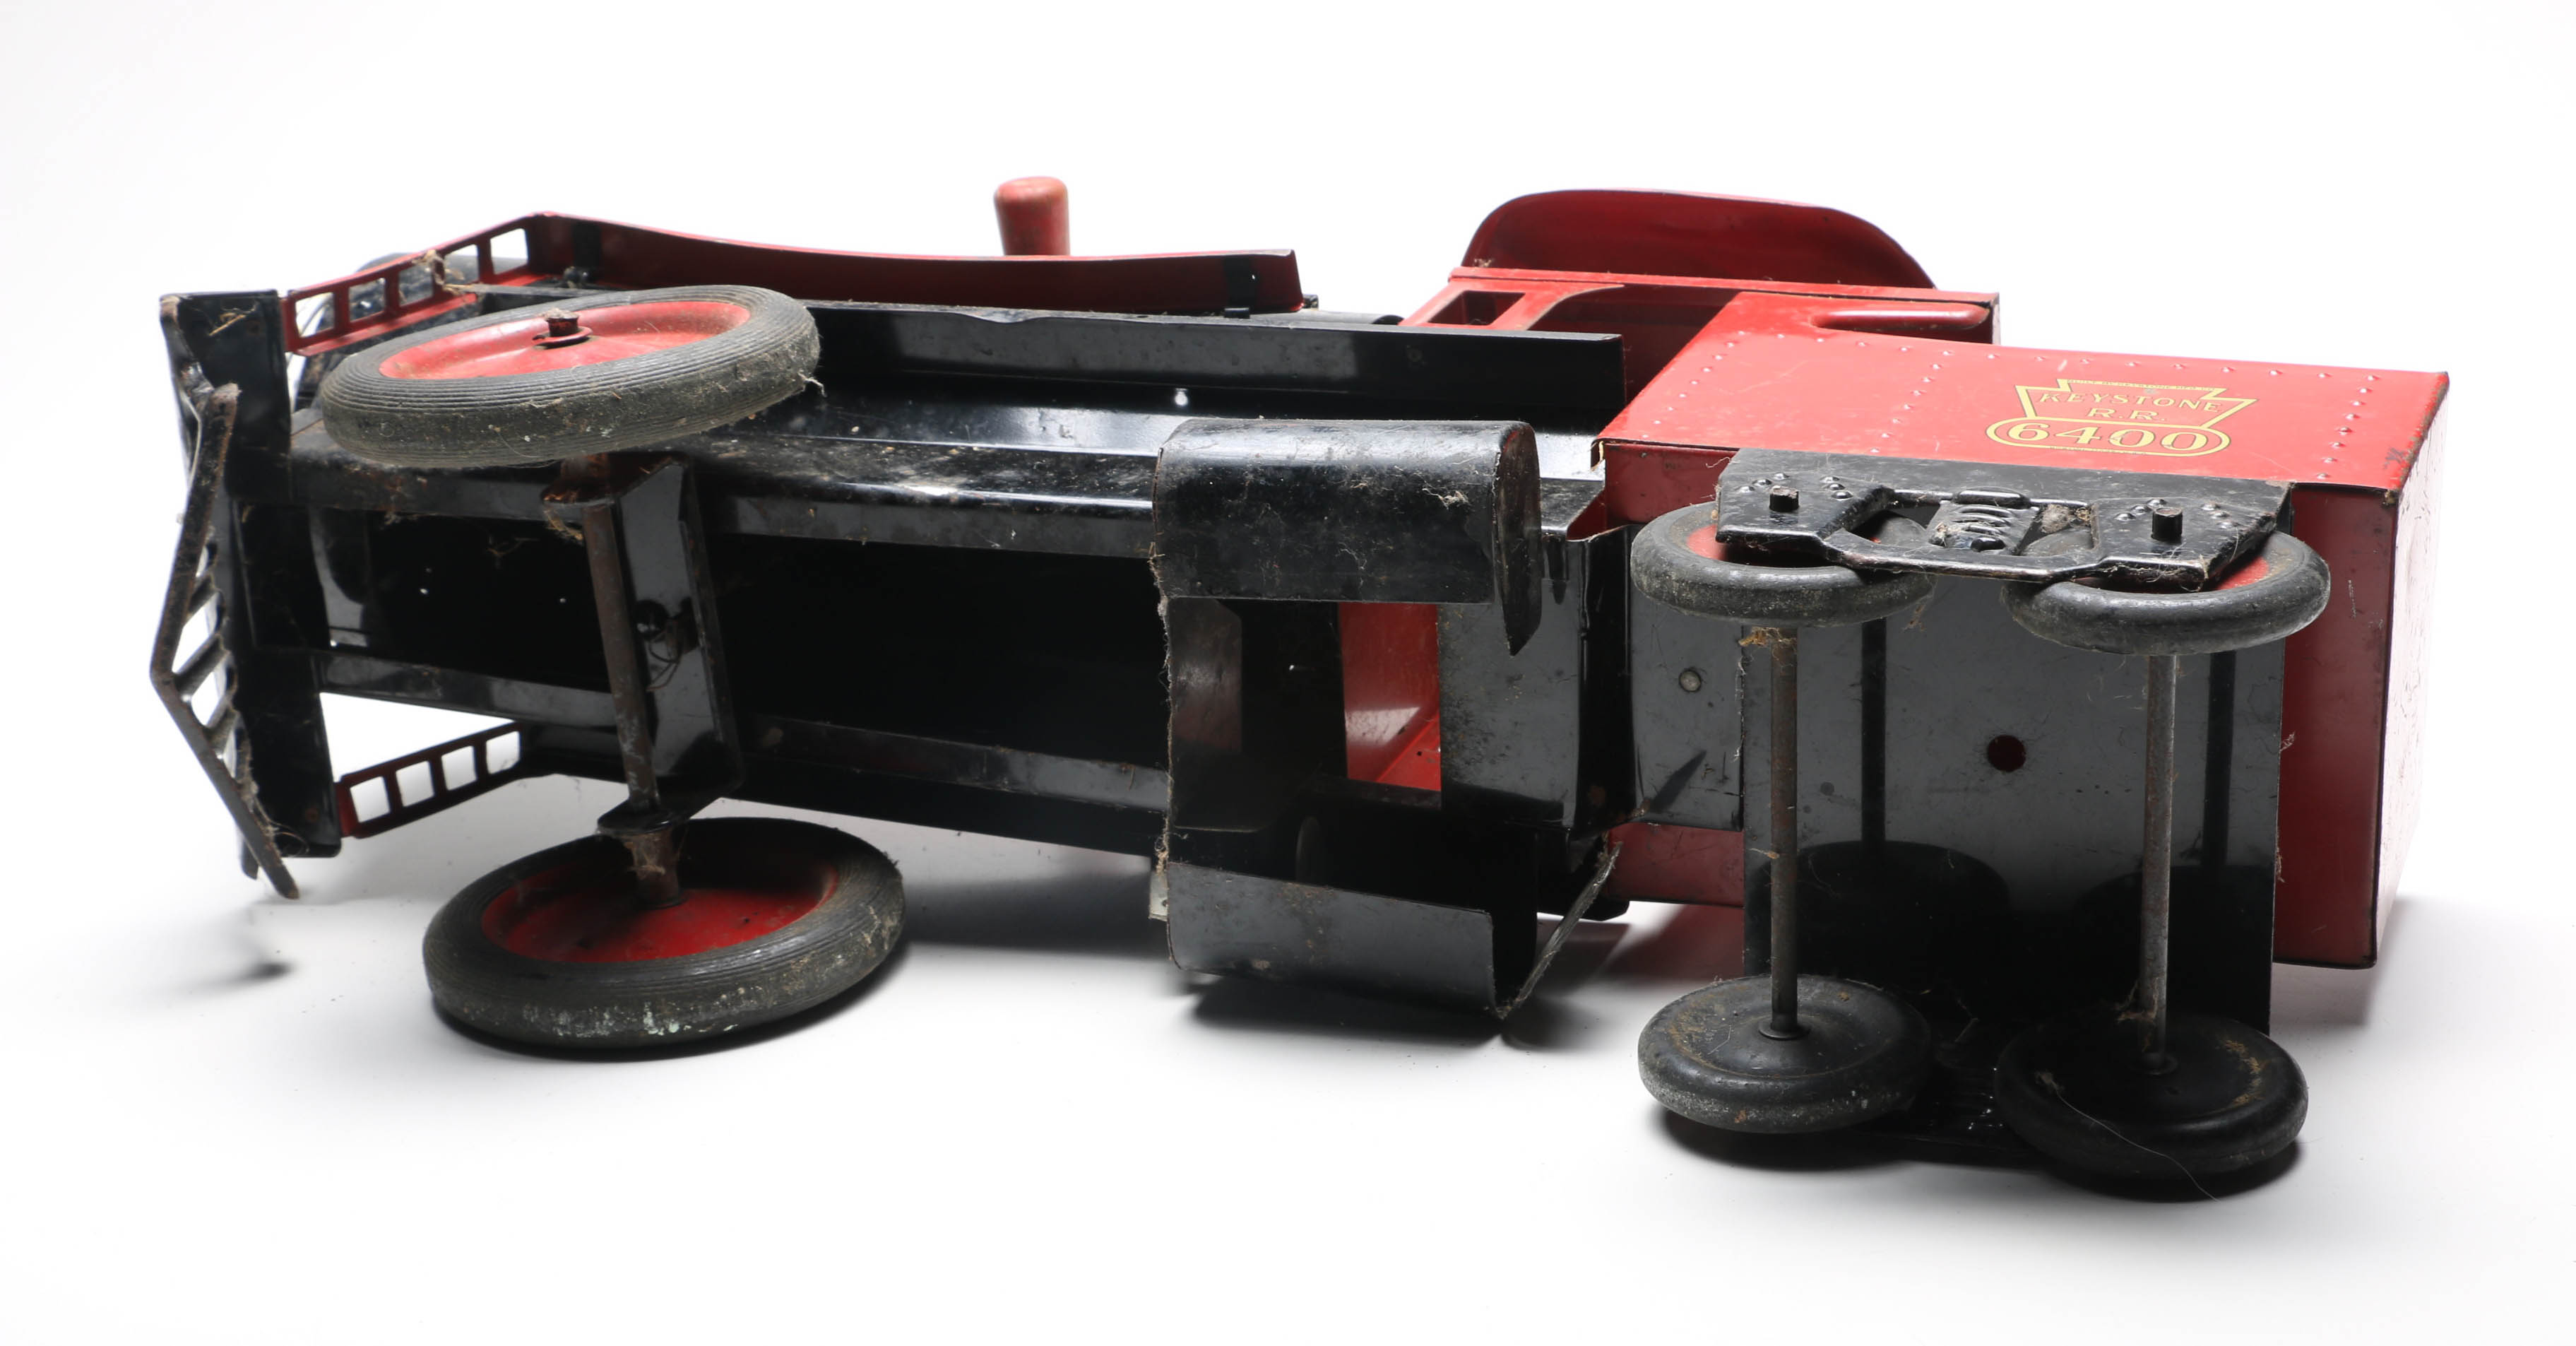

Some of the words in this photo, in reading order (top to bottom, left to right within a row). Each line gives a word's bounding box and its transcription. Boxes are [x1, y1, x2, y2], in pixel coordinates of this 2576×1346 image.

[2039, 393, 2222, 413] KEYSTONE
[2087, 408, 2165, 421] R.R.
[2007, 423, 2209, 451] 6400
